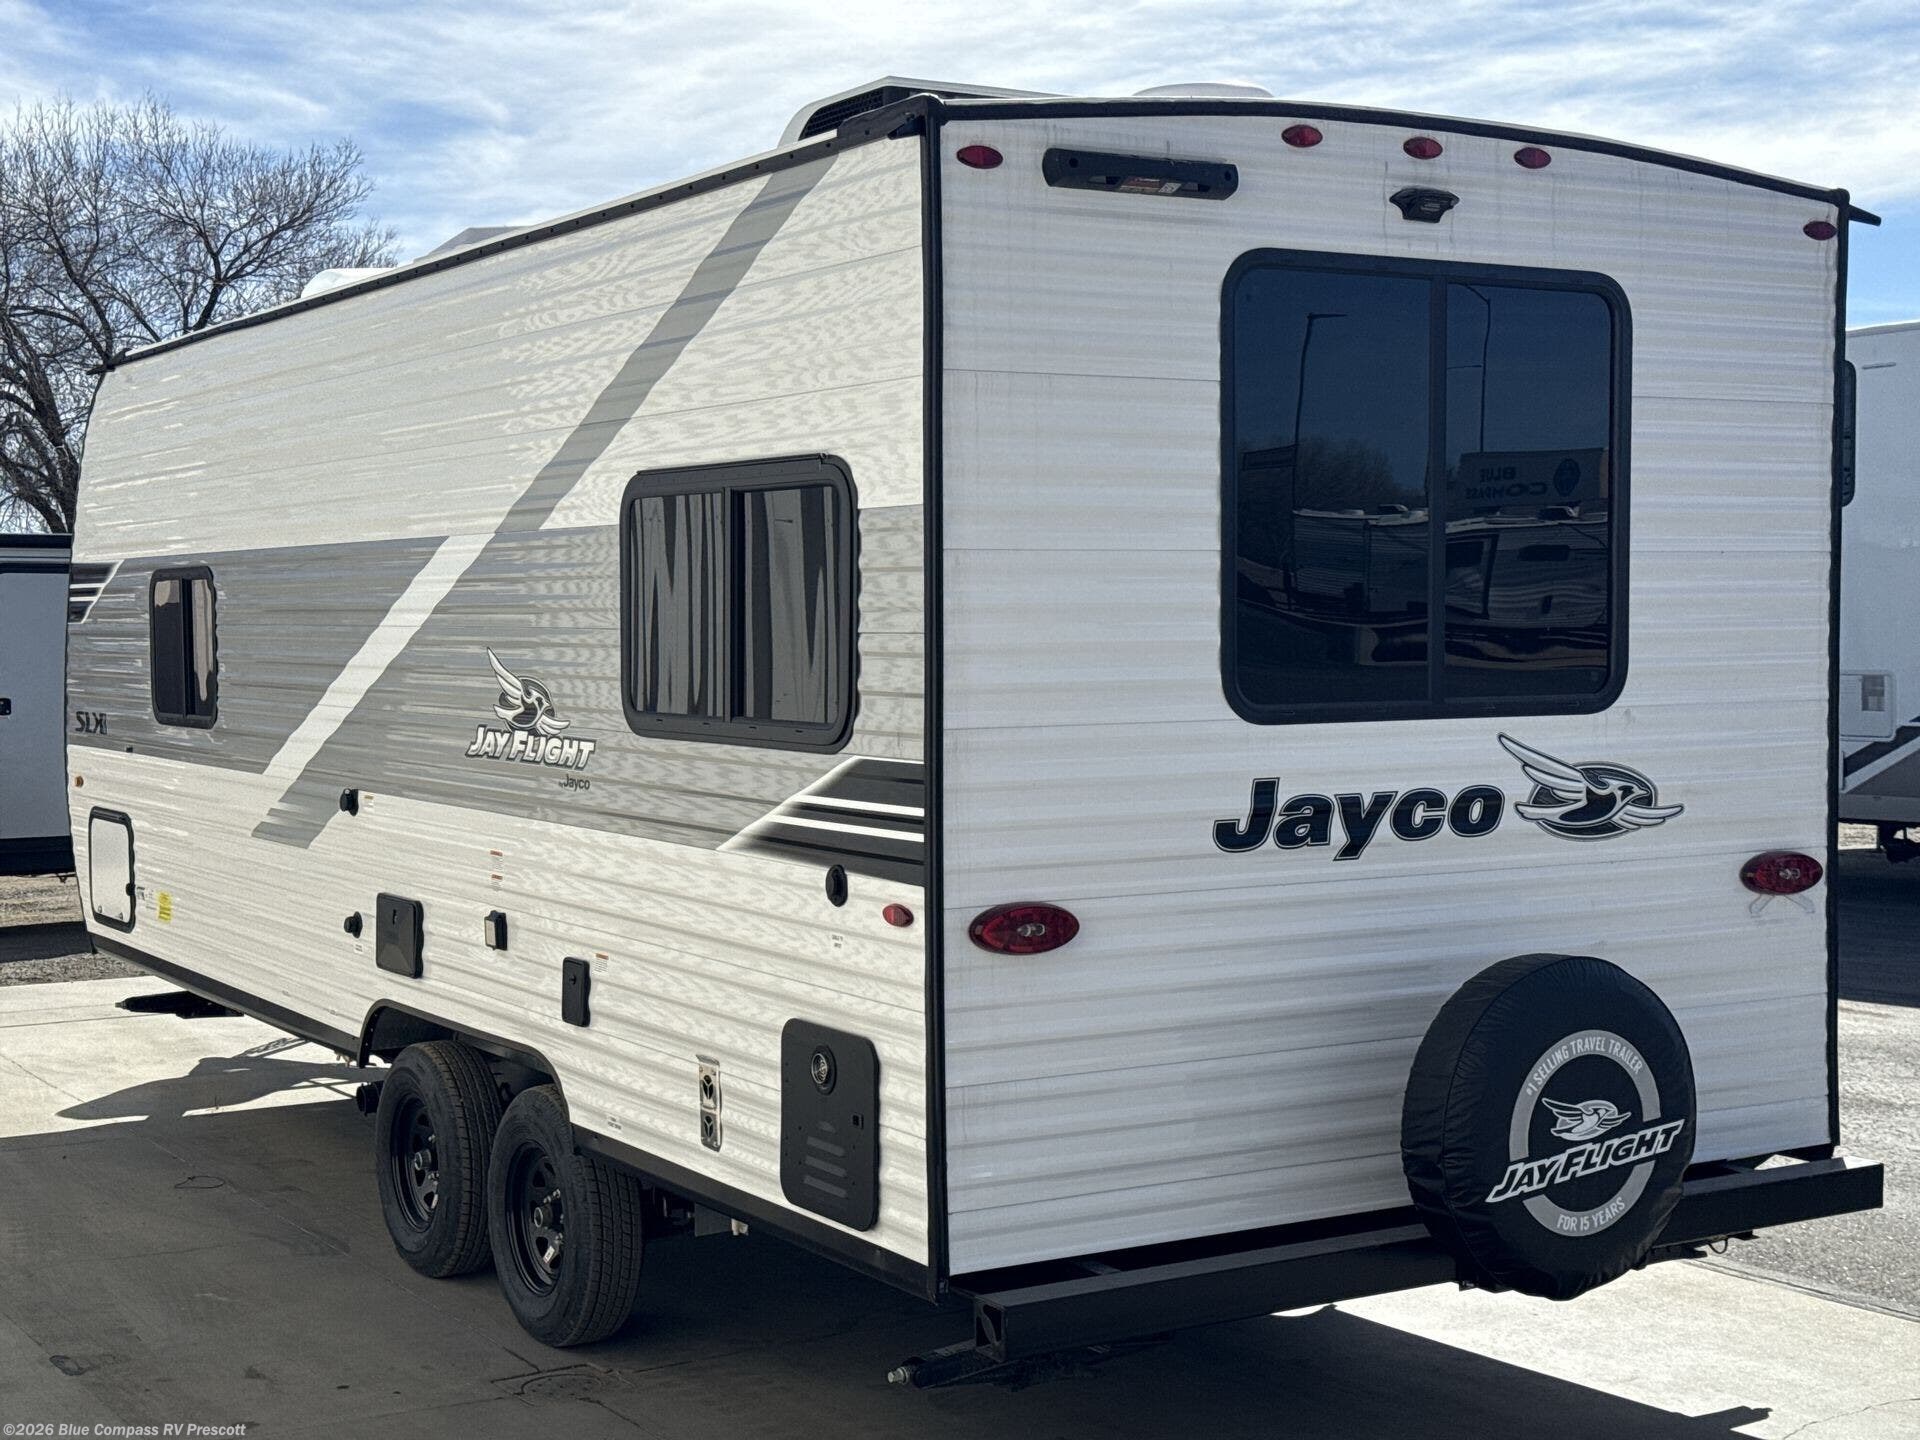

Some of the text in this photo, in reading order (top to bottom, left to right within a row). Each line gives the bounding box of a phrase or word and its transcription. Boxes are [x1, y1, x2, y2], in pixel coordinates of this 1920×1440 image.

[465, 724, 596, 771] JAY FLIGHT
[562, 773, 591, 792] Jayco
[1212, 776, 1506, 862] Jayco
[1533, 1044, 1570, 1085] SELLING
[1569, 1036, 1607, 1056] TRAVEL
[1607, 1039, 1643, 1076] TRAILER
[1485, 1118, 1685, 1203] JAY FLIGHT
[1556, 1195, 1626, 1232] FOR 15 YEARS
